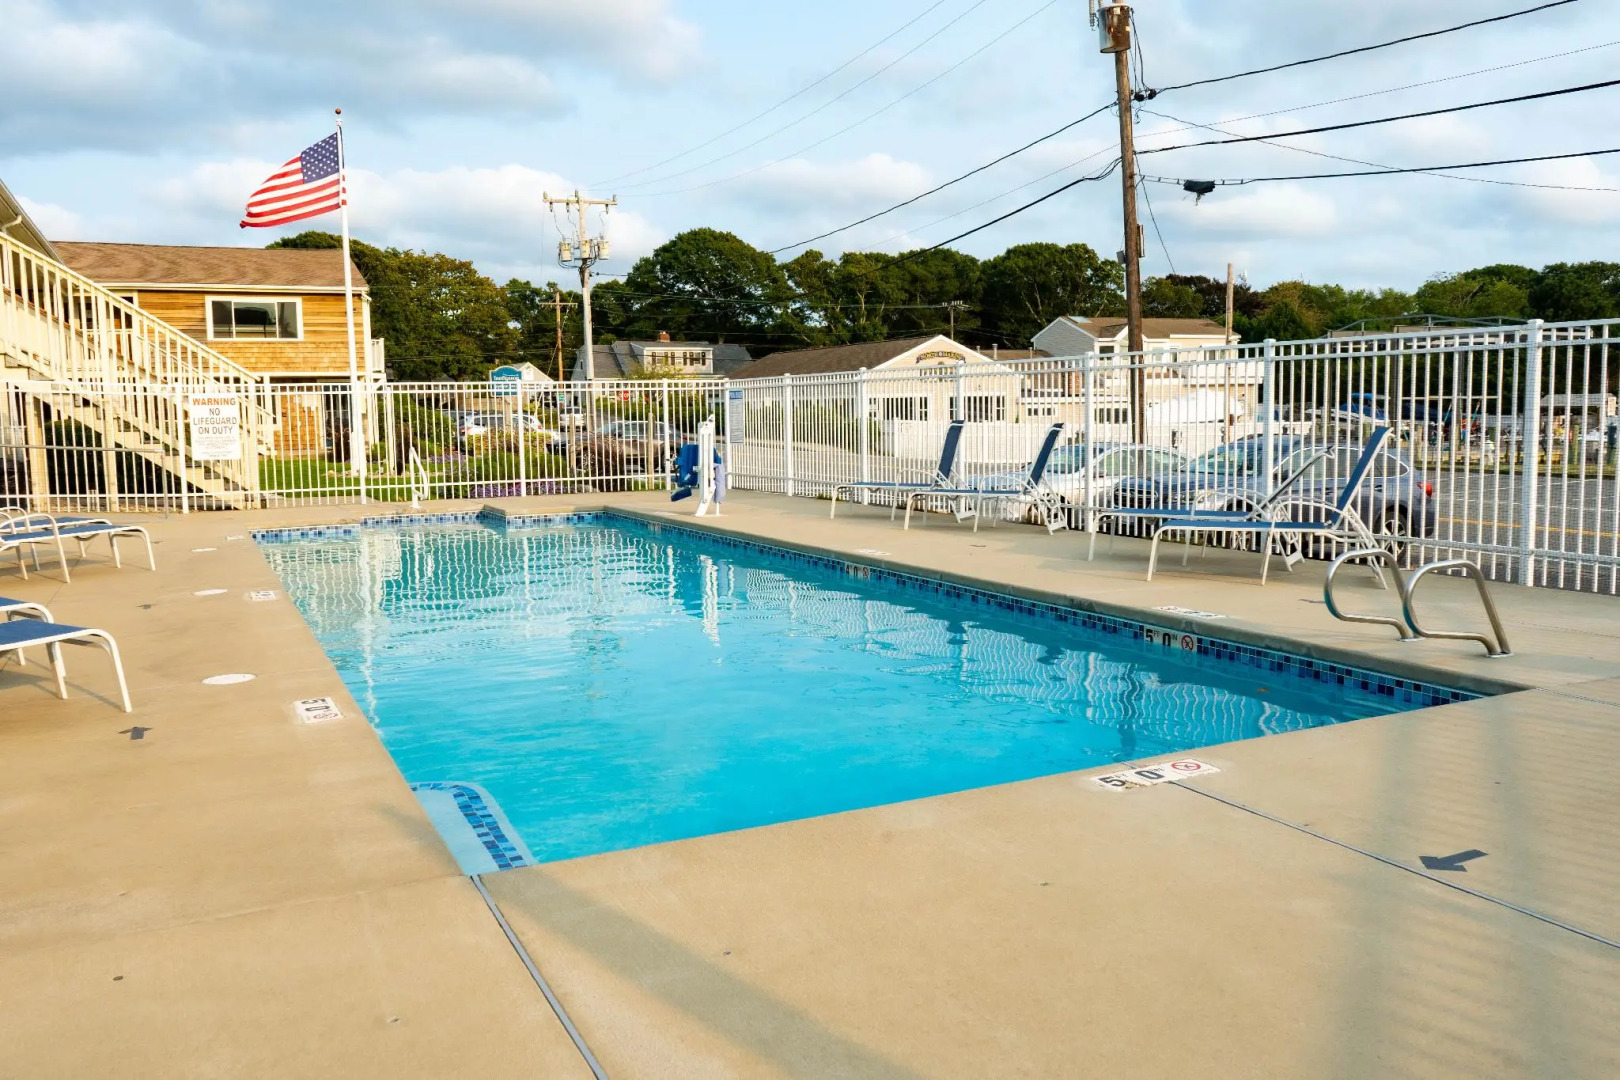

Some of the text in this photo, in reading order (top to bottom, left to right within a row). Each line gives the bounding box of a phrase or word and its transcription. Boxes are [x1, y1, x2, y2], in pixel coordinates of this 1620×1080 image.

[193, 397, 236, 406] WARNING
[209, 407, 221, 416] NO
[193, 417, 237, 426] LIFEGUARD
[198, 426, 233, 435] ON DUTY
[1145, 628, 1153, 643] 5
[1098, 775, 1126, 788] 5
[1134, 770, 1165, 780] 0
